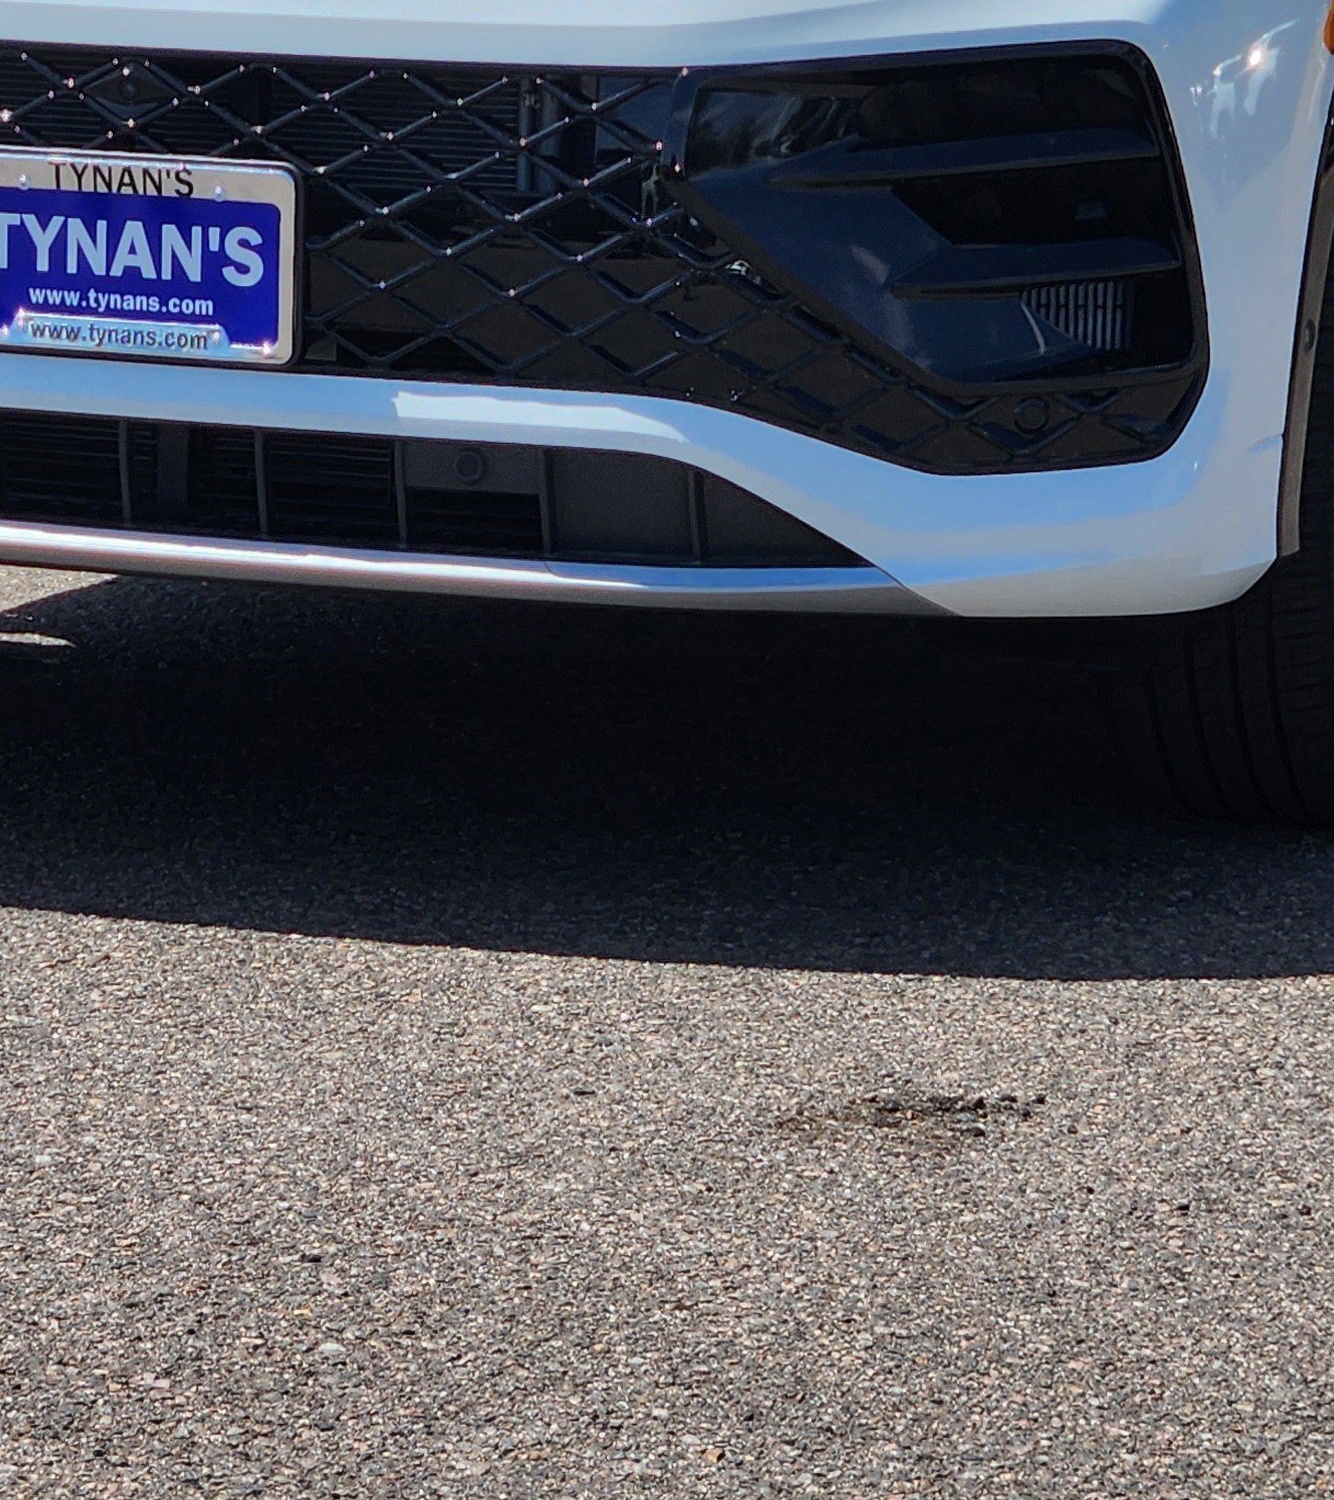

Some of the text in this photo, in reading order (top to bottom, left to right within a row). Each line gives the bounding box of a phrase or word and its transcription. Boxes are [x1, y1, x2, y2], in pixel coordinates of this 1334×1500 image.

[48, 161, 194, 198] TYNAN'S
[29, 286, 214, 316] www.tynans.com
[30, 319, 209, 351] www.tynans.com
